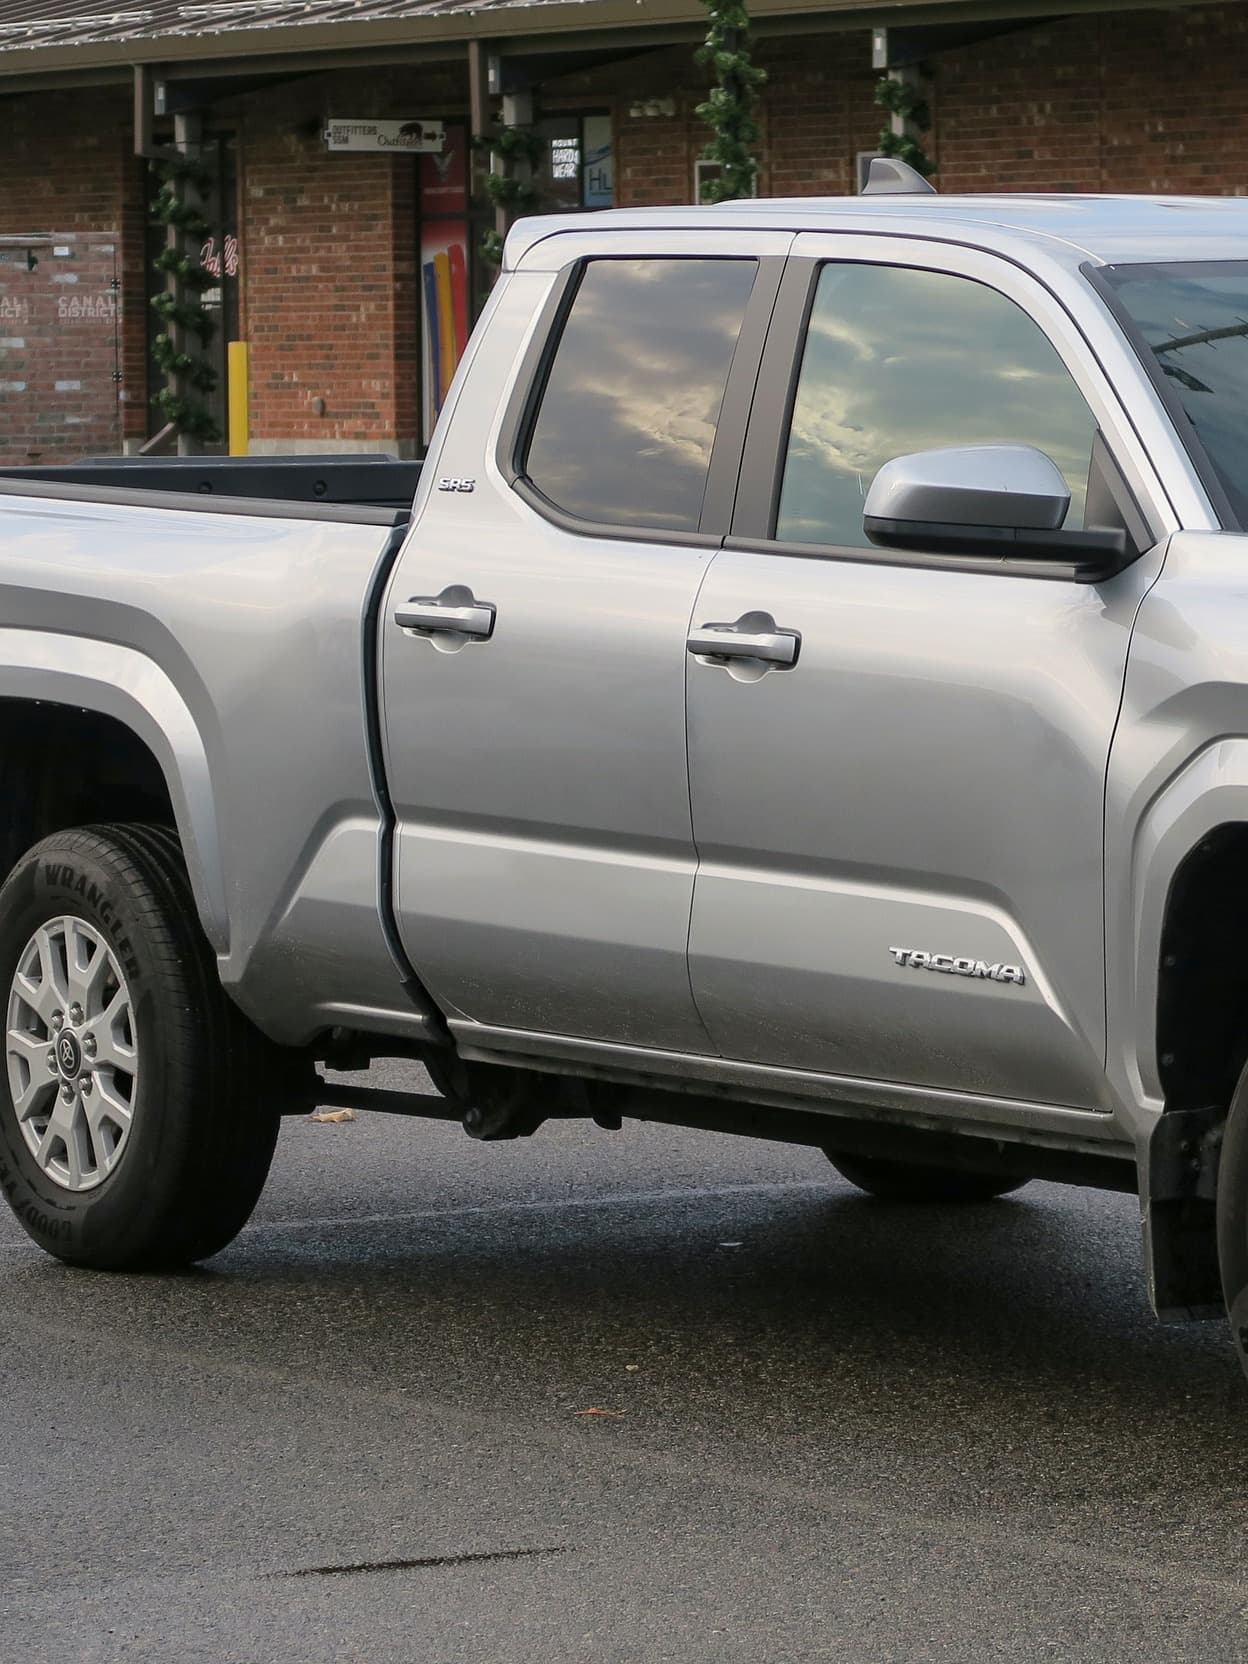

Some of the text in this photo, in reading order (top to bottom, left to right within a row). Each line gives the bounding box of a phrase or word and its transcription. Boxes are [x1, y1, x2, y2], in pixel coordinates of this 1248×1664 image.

[332, 125, 377, 136] OUTFITTERS
[552, 163, 577, 178] WEAR
[58, 295, 116, 307] CANAL
[58, 306, 116, 318] DISTRICT
[438, 478, 476, 492] SR5
[45, 864, 141, 981] WRANGLER
[888, 946, 1026, 985] TACOMA
